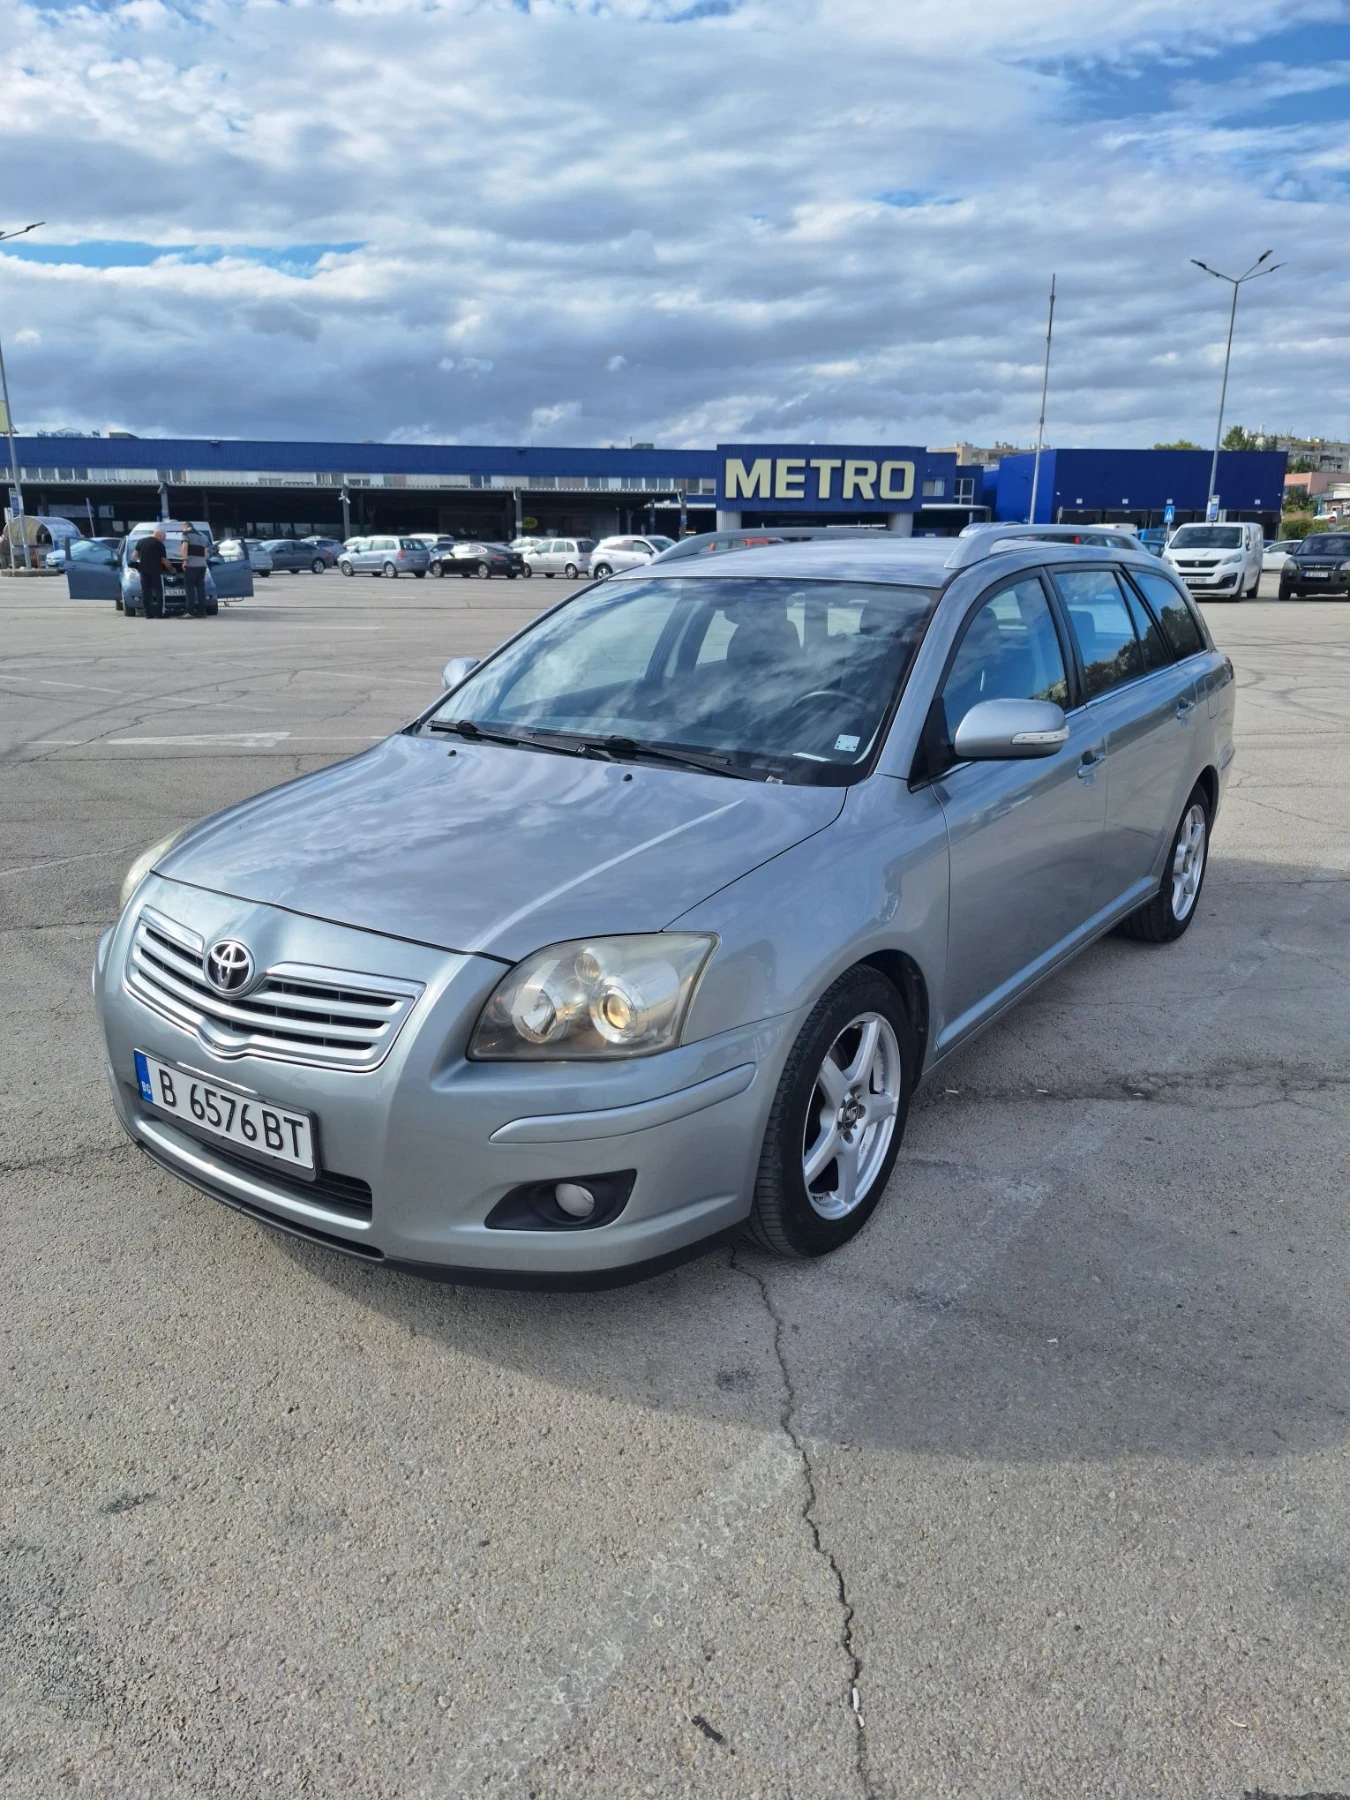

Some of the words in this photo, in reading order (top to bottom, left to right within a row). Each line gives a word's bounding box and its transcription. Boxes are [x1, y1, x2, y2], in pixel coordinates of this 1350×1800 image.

[725, 458, 915, 499] METRO
[141, 1080, 152, 1095] BG
[159, 1068, 177, 1107] B
